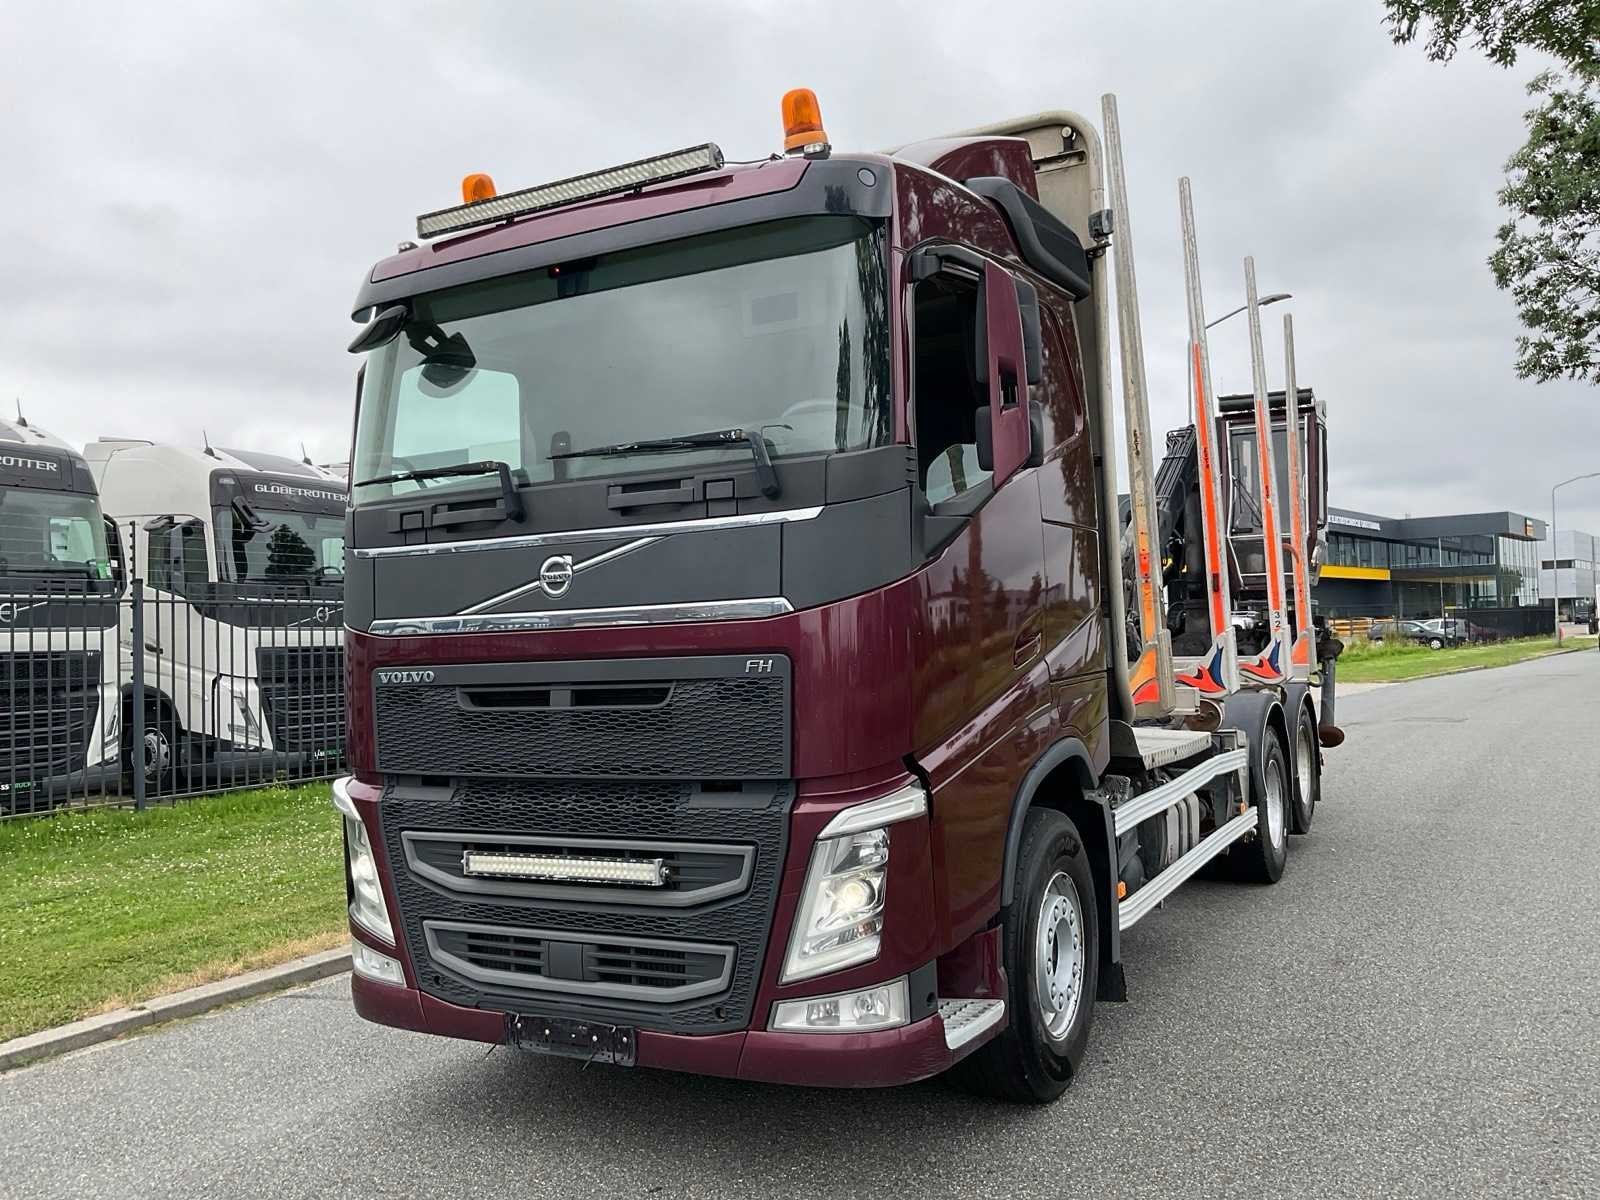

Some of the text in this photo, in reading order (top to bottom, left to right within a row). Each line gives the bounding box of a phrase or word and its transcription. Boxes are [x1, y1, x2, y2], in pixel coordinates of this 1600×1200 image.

[254, 484, 349, 502] GLOBETROTTER
[745, 659, 773, 673] FH
[378, 671, 434, 684] VOLVO
